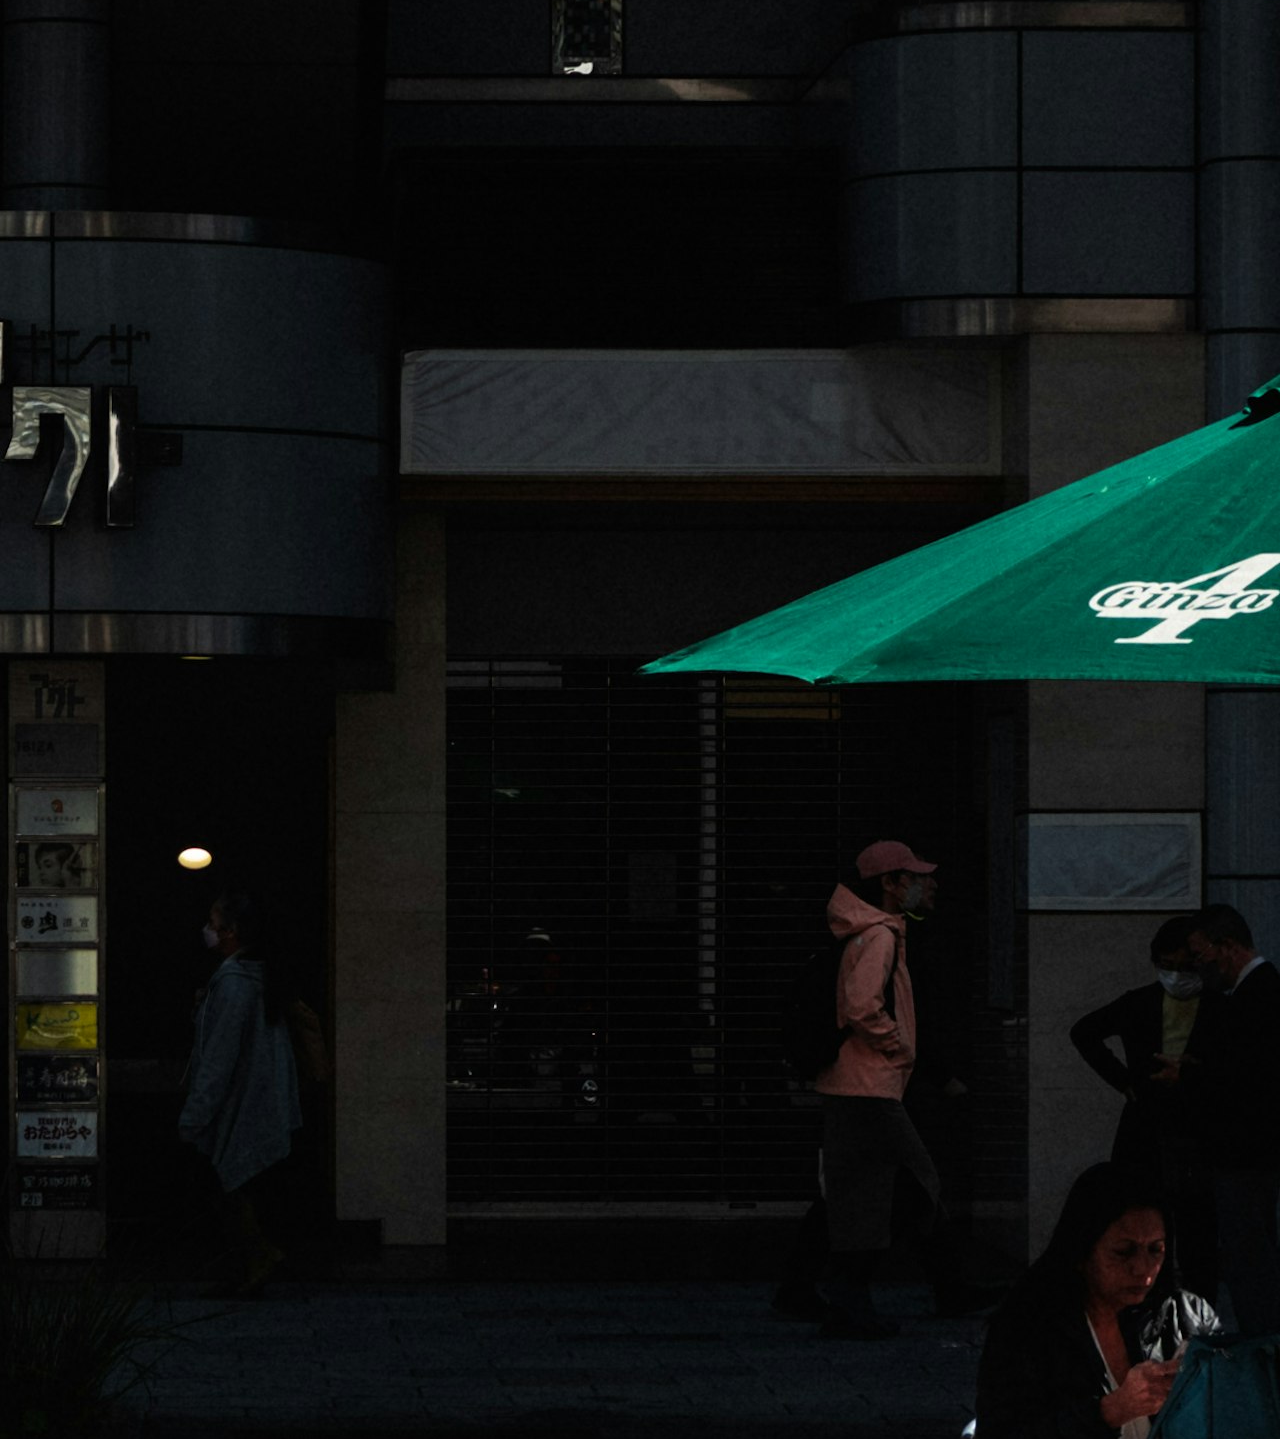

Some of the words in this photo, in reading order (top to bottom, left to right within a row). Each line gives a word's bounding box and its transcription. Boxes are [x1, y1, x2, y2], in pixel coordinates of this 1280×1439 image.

[1092, 583, 1277, 612] Ginza
[24, 1126, 91, 1140] おたからや
